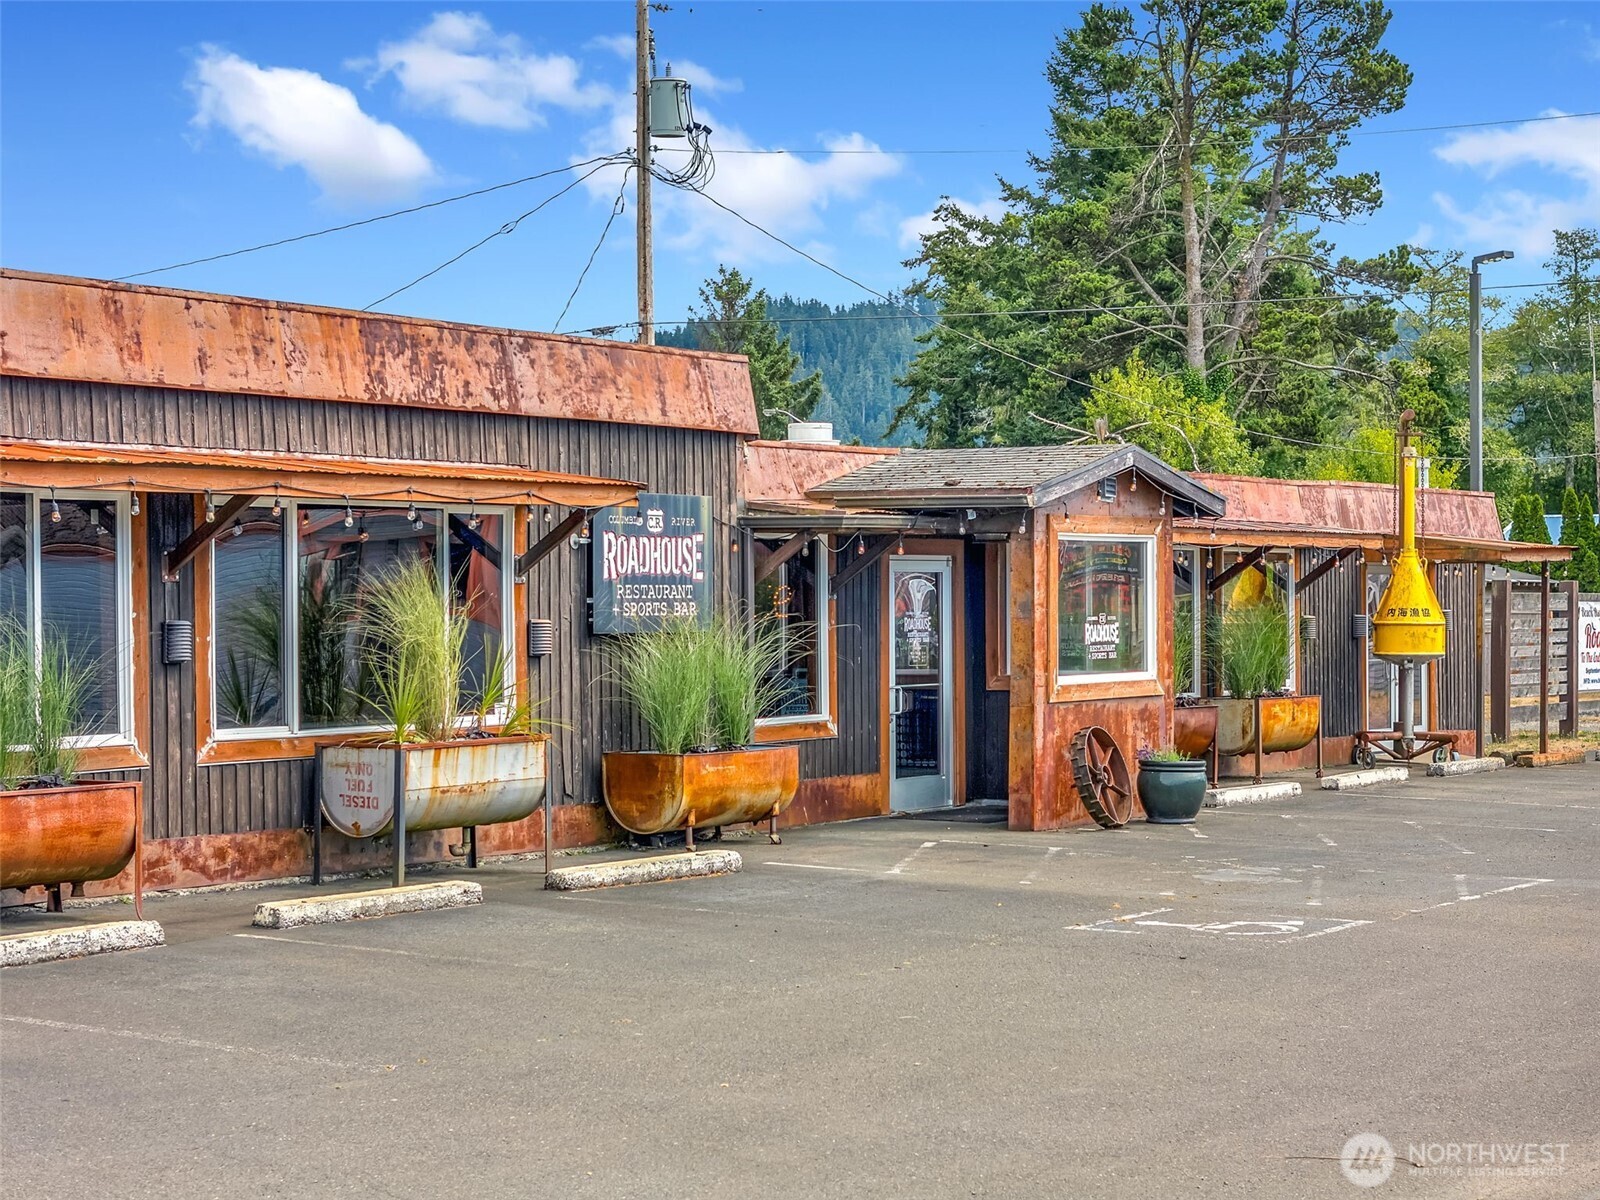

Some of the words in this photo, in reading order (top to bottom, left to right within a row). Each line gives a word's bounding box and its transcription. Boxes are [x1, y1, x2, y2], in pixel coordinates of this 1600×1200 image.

[671, 517, 696, 527] RIVER
[602, 530, 704, 581] ROADHOUSE
[616, 584, 694, 599] RESTAURANT
[623, 602, 668, 617] SPORTS
[673, 602, 698, 616] BAR
[1085, 622, 1120, 645] ROADHOUSE
[345, 763, 372, 776] ONLY
[345, 779, 372, 792] FUEL
[339, 794, 378, 809] DIESEL
